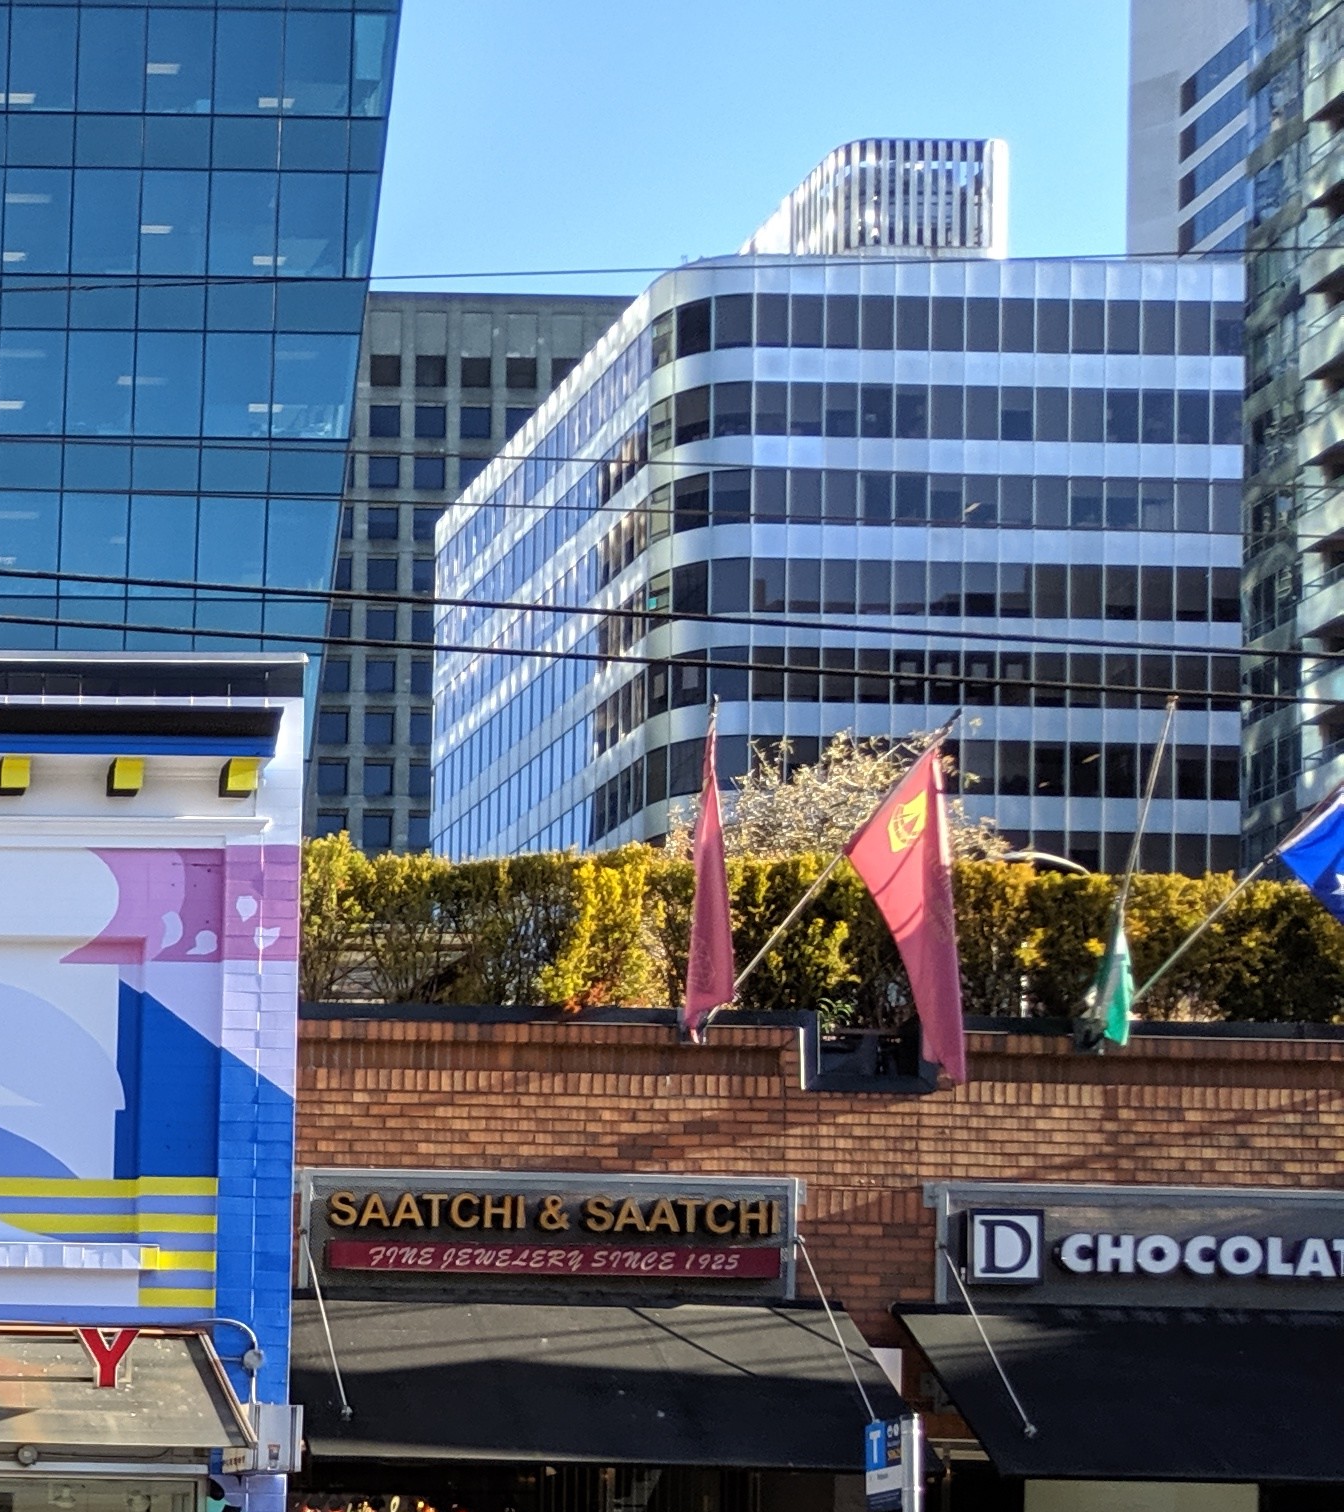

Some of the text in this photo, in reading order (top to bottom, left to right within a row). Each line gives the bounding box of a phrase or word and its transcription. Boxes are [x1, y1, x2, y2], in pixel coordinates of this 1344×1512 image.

[329, 1191, 782, 1234] SAATCHI & SAATCHI
[368, 1247, 741, 1270] FINE JEWELERY SINCE 1925
[979, 1219, 1033, 1275] D
